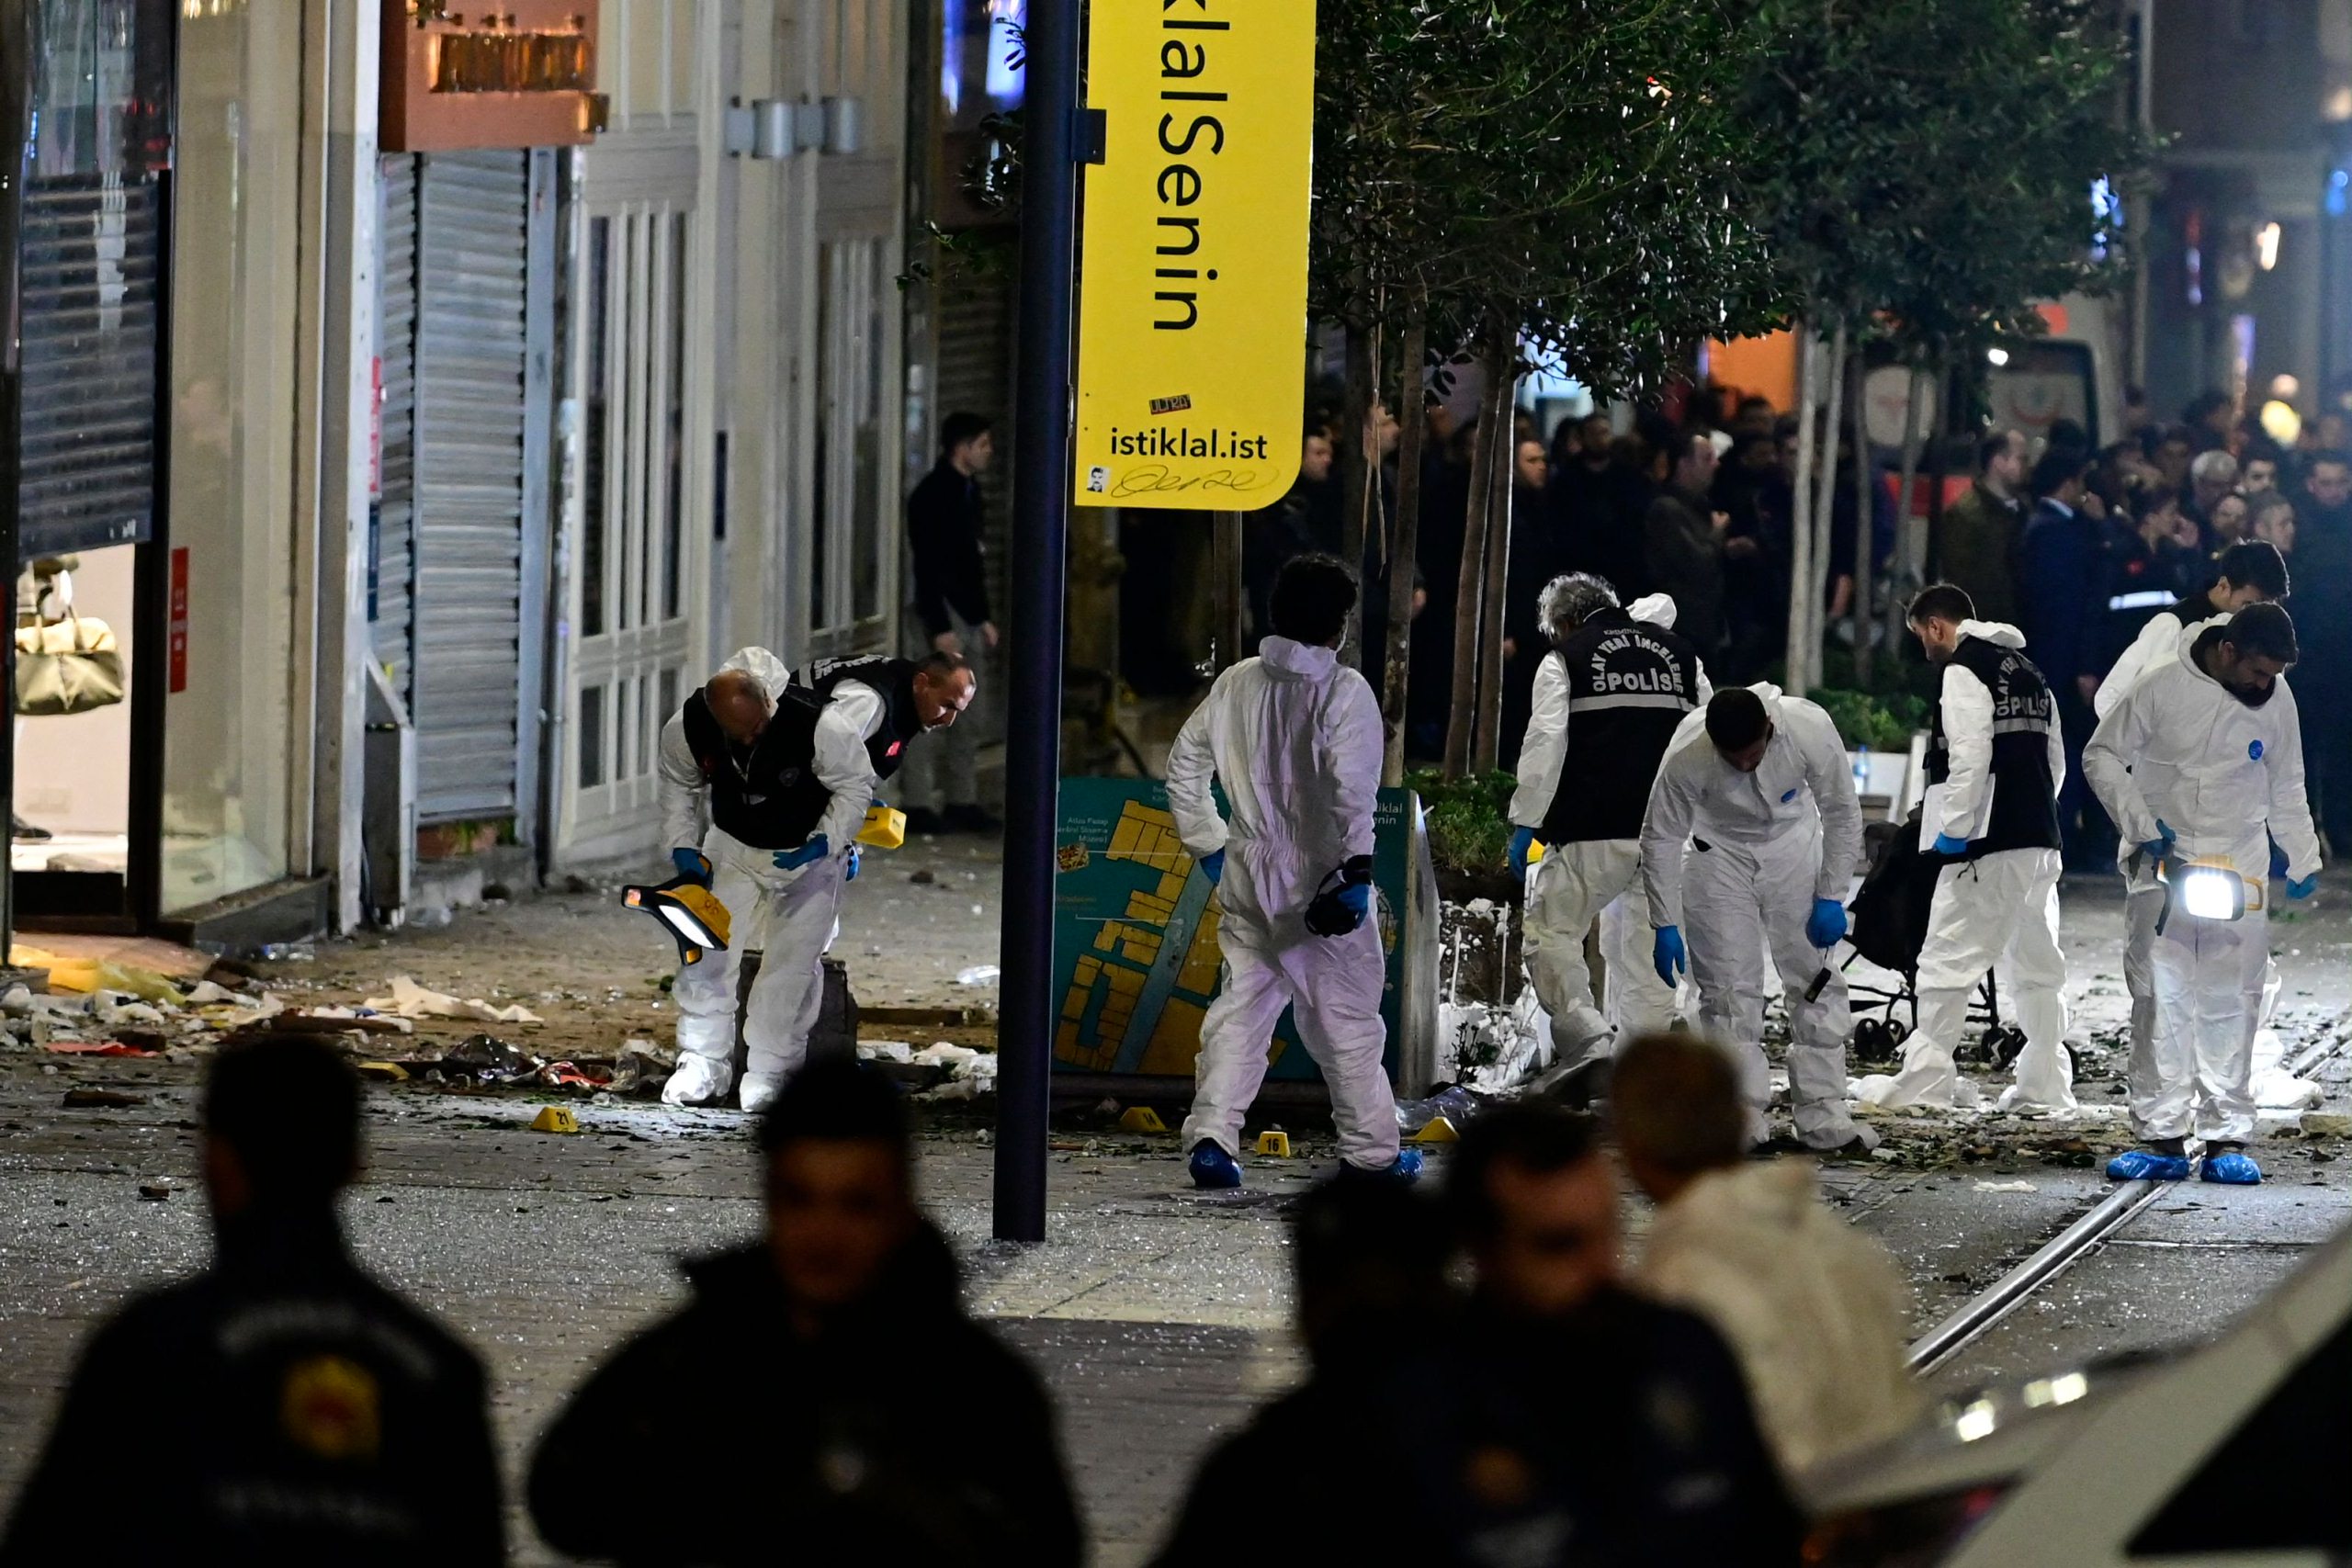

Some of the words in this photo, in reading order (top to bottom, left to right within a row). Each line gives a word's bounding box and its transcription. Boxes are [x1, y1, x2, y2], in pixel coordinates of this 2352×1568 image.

[1111, 426, 1268, 460] istiklal.ist
[1591, 652, 1607, 692] OLAY
[1607, 668, 1673, 692] POLİS
[1996, 674, 2010, 716] OLAY
[556, 1111, 570, 1125] 21
[1266, 1138, 1280, 1152] 16
